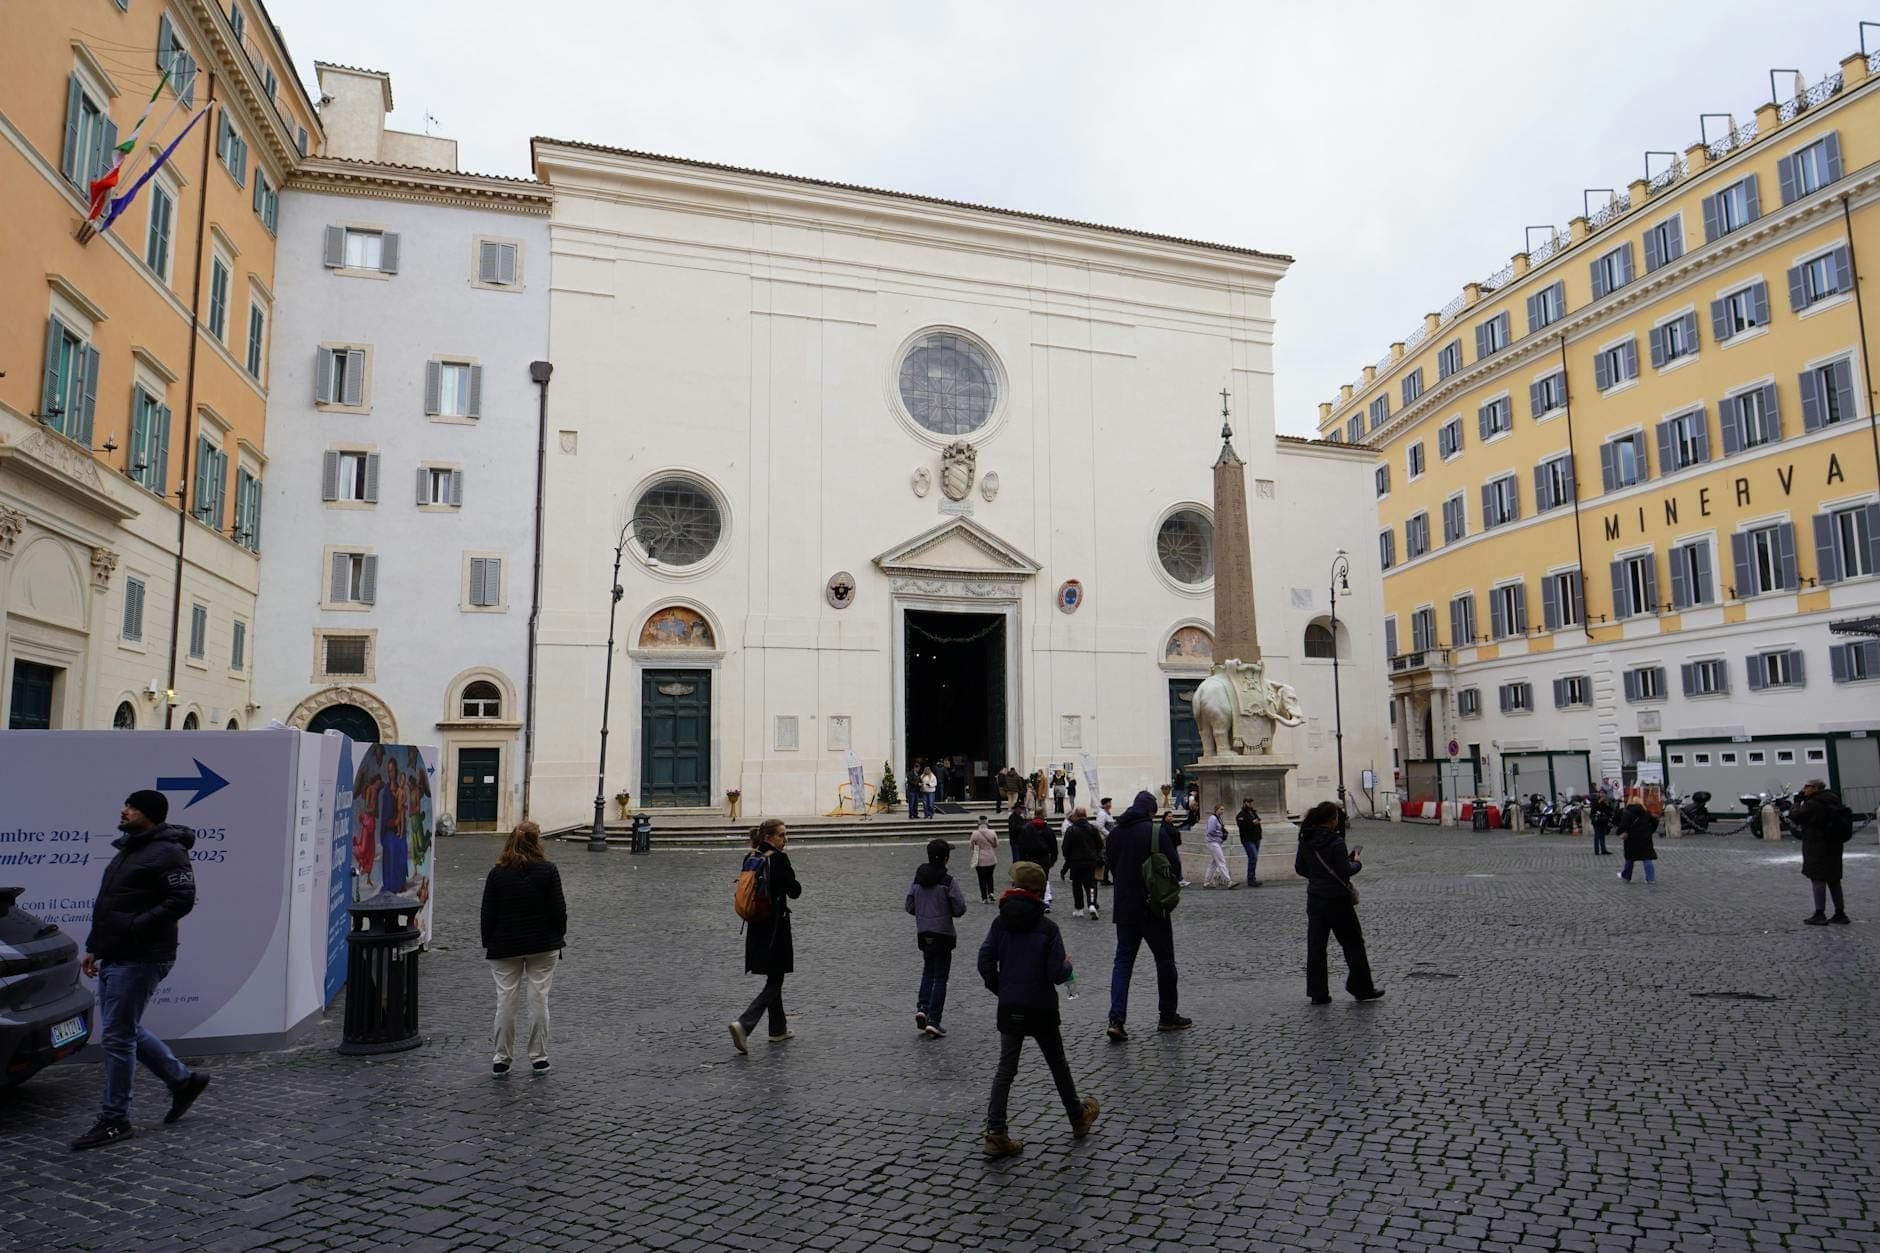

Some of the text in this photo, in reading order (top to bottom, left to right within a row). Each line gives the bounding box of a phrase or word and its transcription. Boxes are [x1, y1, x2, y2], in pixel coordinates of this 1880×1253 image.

[1604, 453, 1844, 541] MINERVA
[49, 830, 90, 843] 2024
[48, 853, 90, 866] 2024
